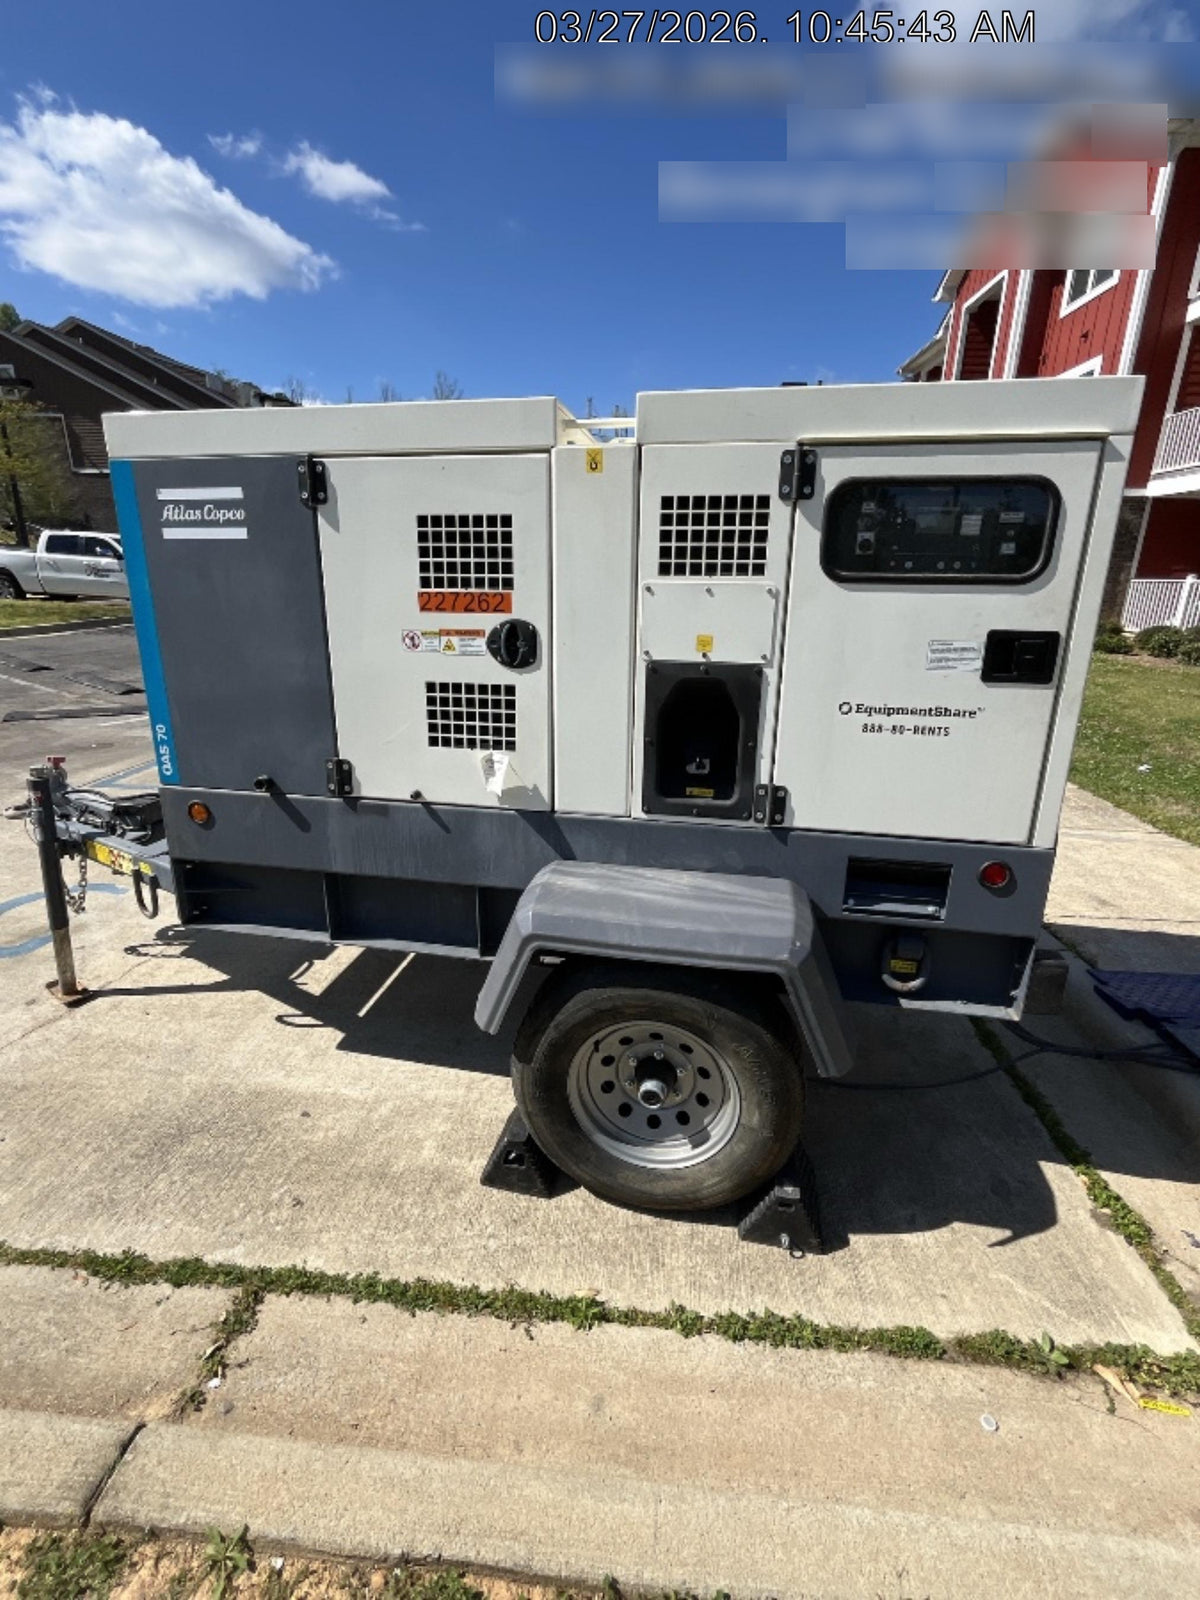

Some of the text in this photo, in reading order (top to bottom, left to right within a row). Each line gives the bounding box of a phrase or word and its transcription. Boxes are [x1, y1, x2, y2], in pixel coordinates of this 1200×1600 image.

[161, 504, 246, 524] Atlas Copco
[420, 592, 506, 612] 227262
[155, 724, 168, 742] 70
[861, 723, 951, 737] 888-80-RENTS
